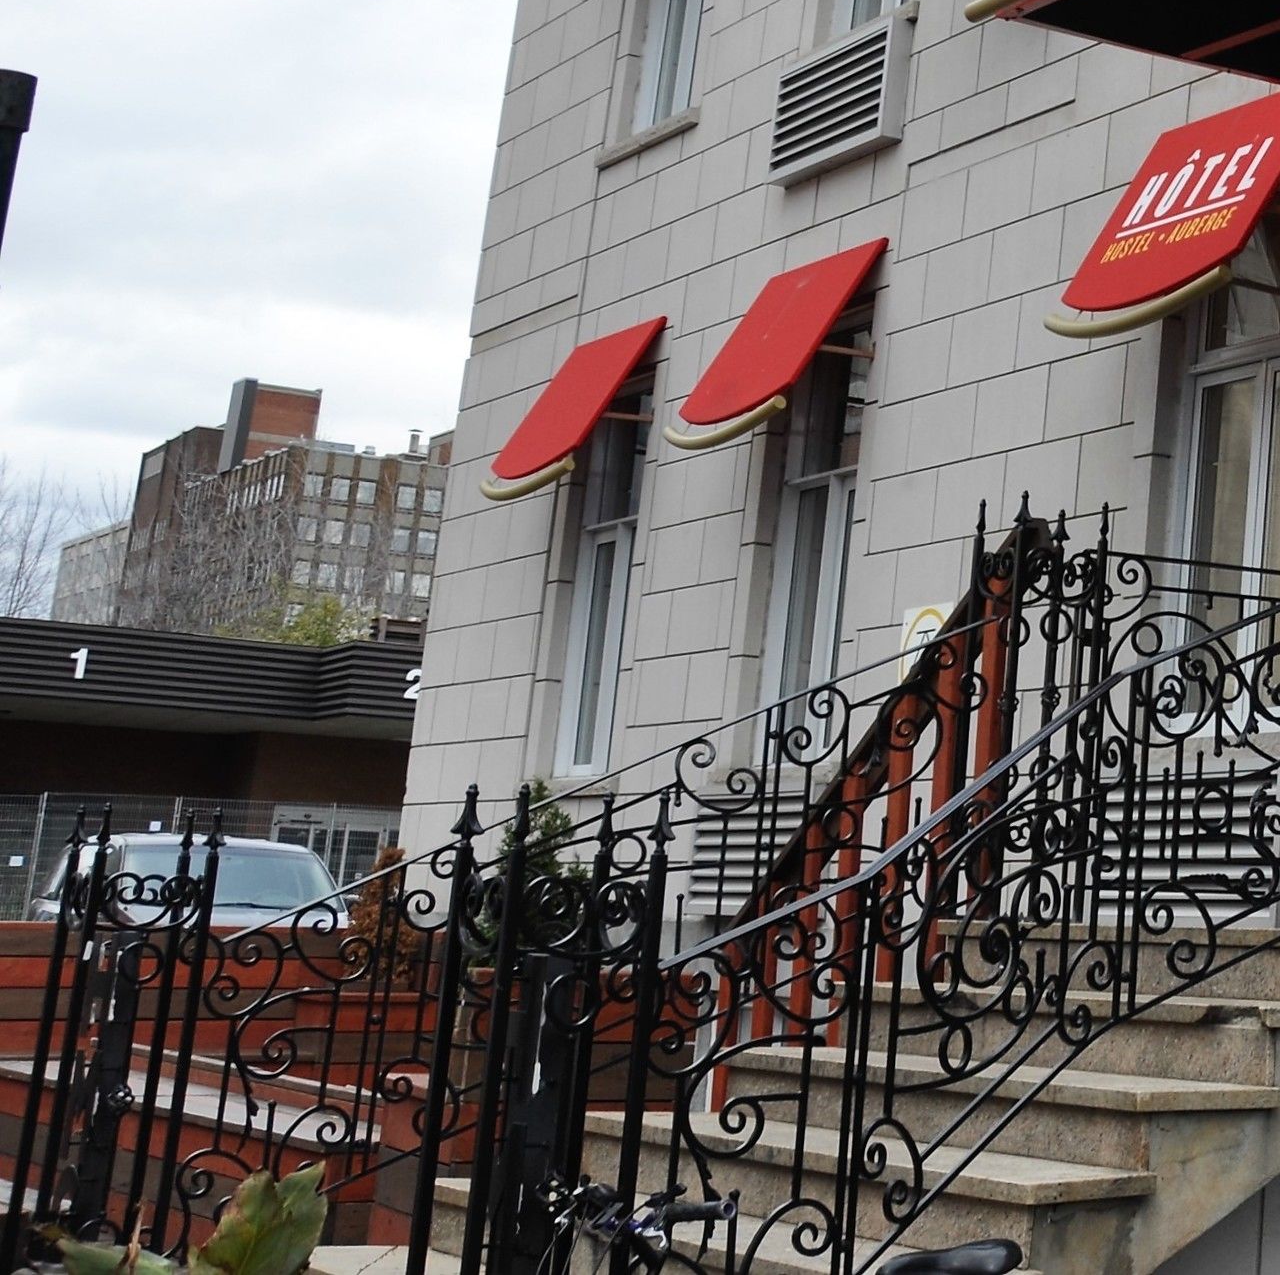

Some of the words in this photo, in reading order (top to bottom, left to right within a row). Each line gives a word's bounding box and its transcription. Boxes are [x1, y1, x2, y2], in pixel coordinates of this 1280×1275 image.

[1121, 136, 1275, 229] HÔTEL
[1100, 231, 1154, 265] HOSTEL
[1165, 205, 1239, 246] AUBERGE
[70, 647, 89, 680] 1
[403, 668, 423, 699] 2
